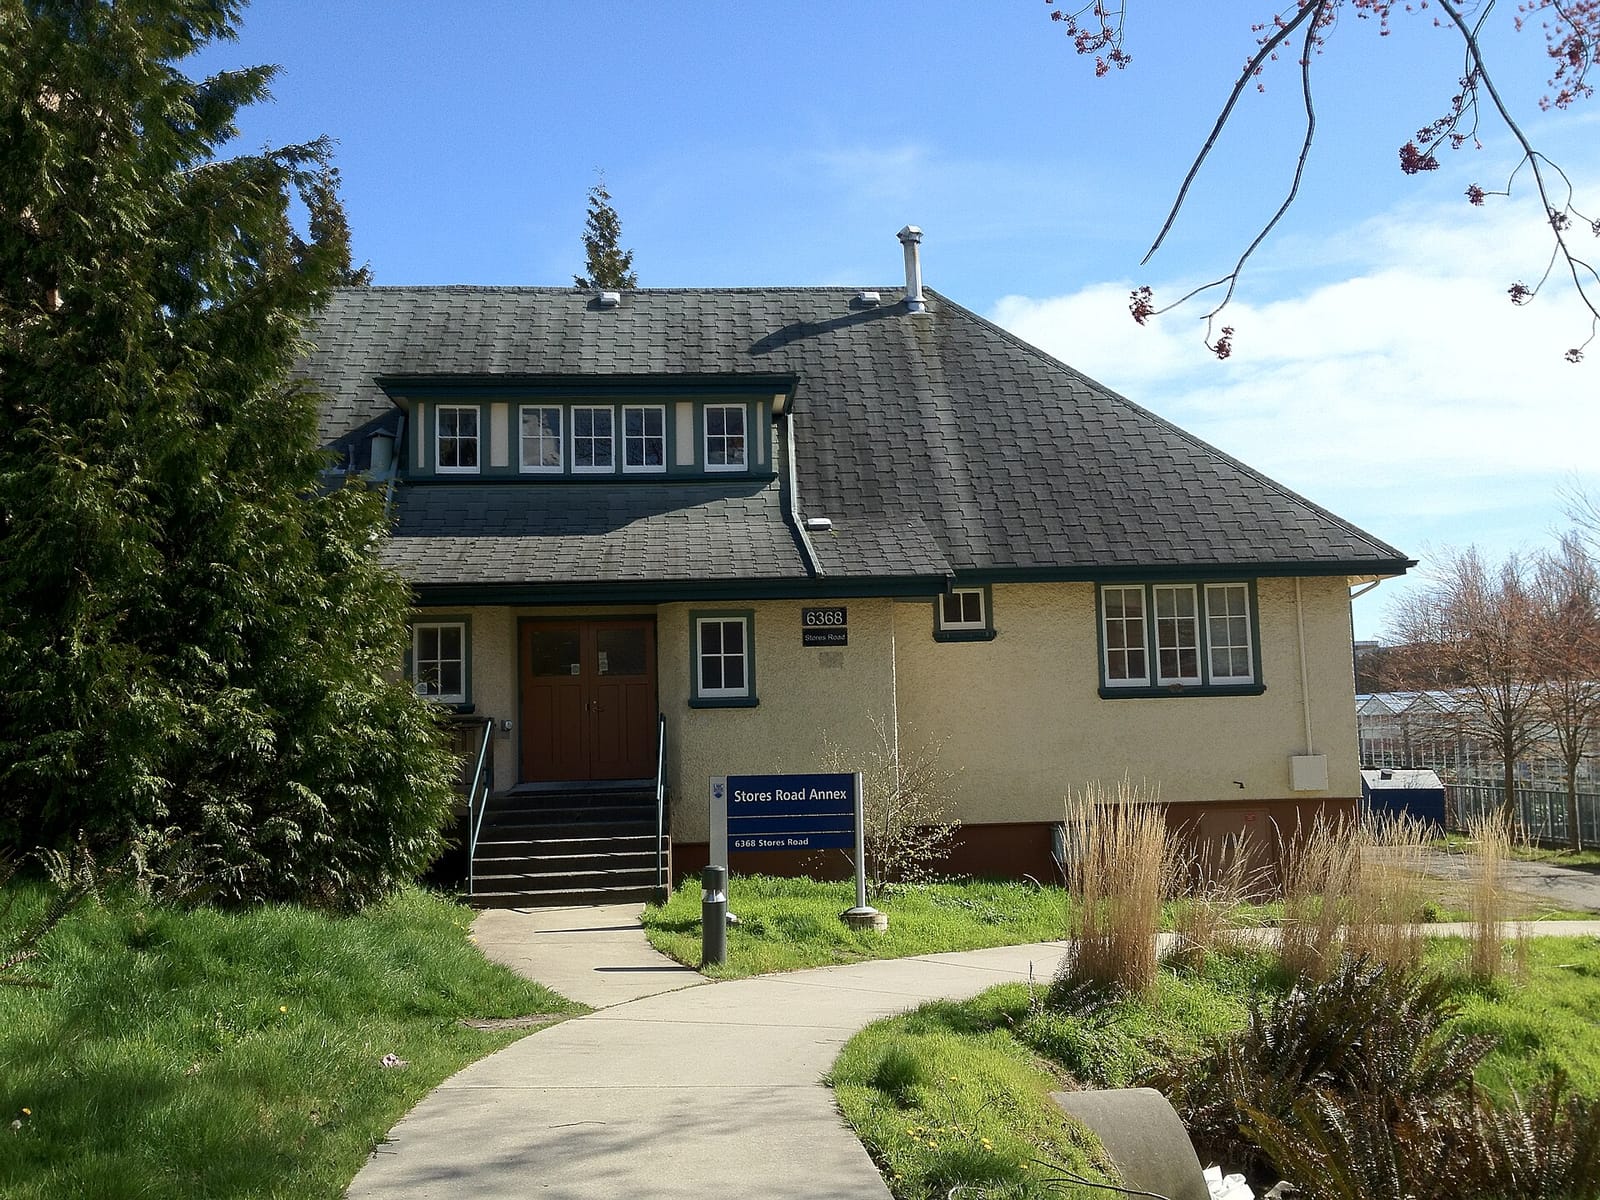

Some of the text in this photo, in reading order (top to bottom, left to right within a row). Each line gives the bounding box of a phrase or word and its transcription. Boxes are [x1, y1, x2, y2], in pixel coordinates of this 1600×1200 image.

[806, 611, 843, 625] 6368
[828, 633, 846, 641] Road
[734, 788, 847, 803] Stores Road Annex
[734, 837, 809, 848] 6368 Stores Road
